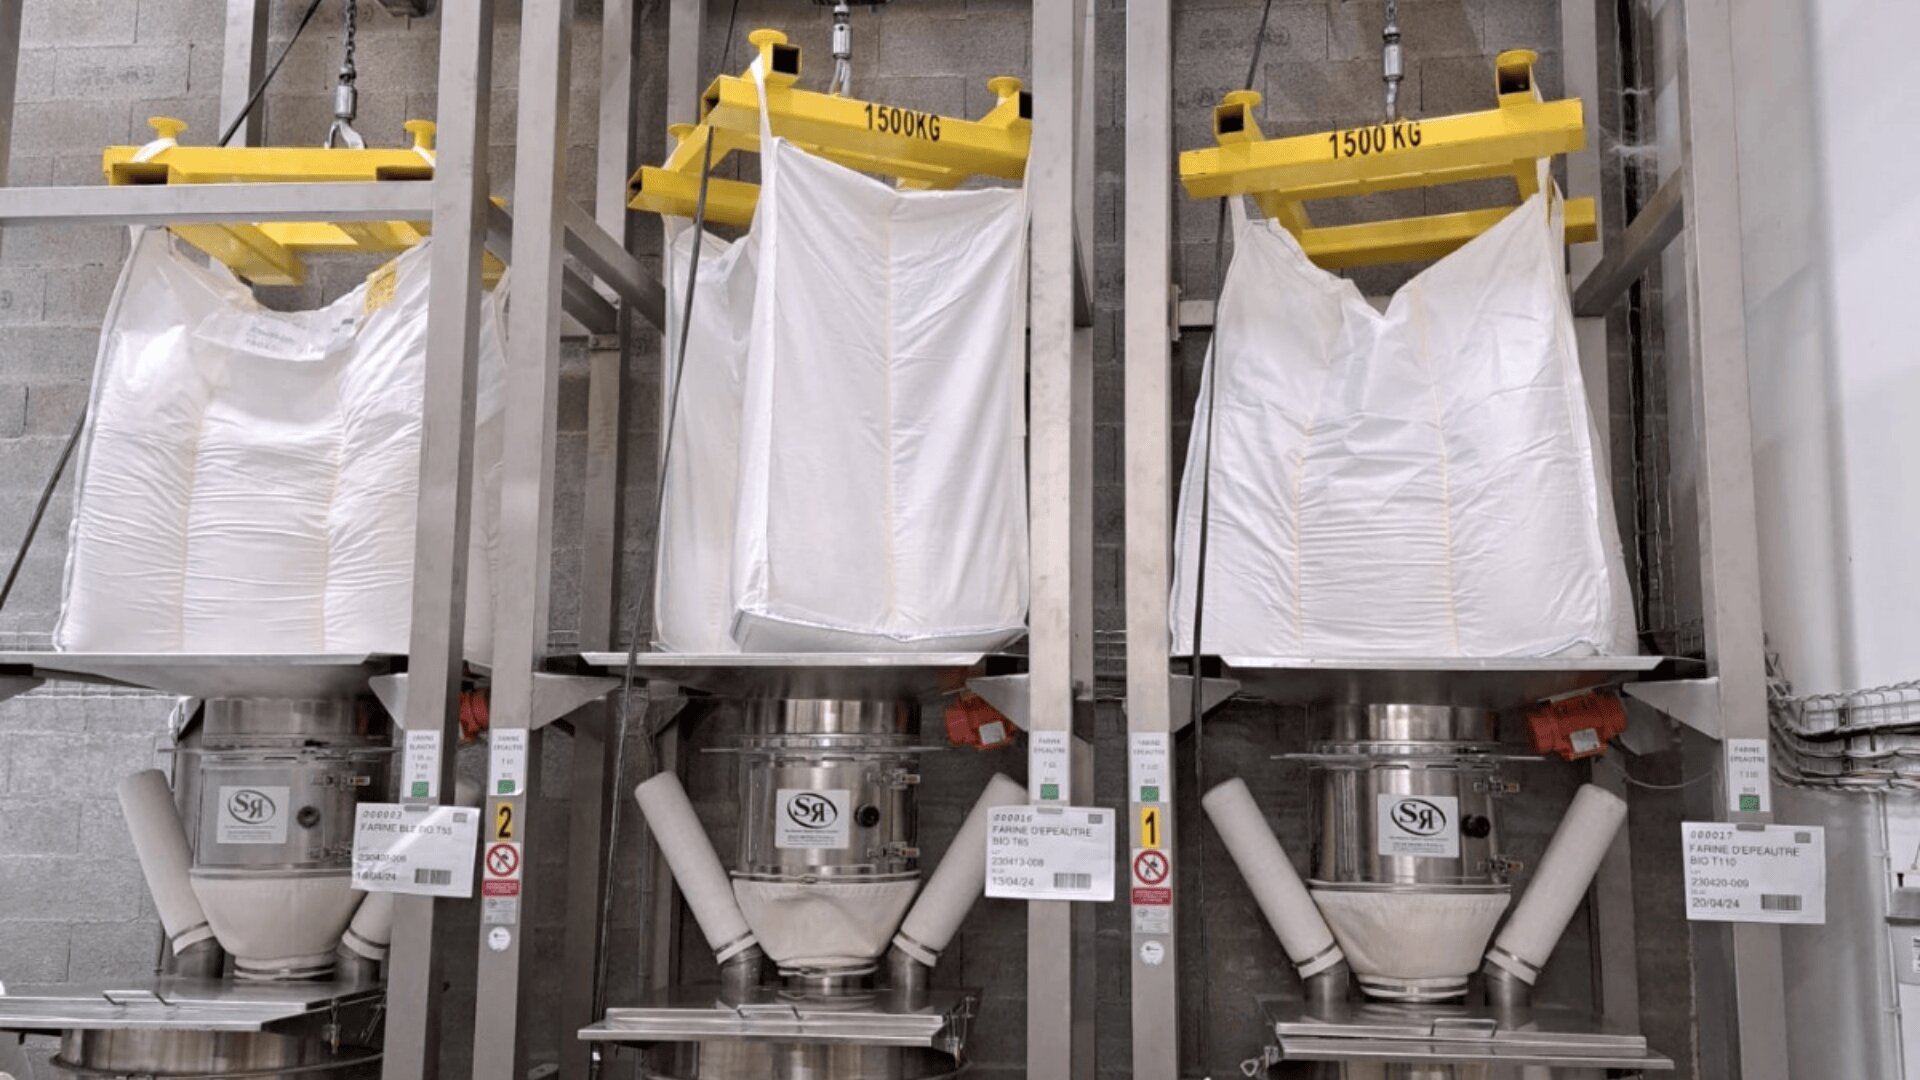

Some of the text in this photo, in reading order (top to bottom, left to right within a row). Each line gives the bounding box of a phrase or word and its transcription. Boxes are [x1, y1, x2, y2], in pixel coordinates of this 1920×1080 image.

[498, 805, 512, 839] 2
[1145, 811, 1155, 845] 1
[360, 823, 397, 834] FARINE
[992, 825, 1092, 838] FARINE D'EPEAUTRE
[992, 837, 1029, 847] BIO T65
[1689, 844, 1800, 857] FARINE D'EPEAUTRE
[1690, 856, 1737, 867] BIO T110
[992, 876, 1034, 887] 13/04/24
[1692, 897, 1740, 909] 20/04/24
